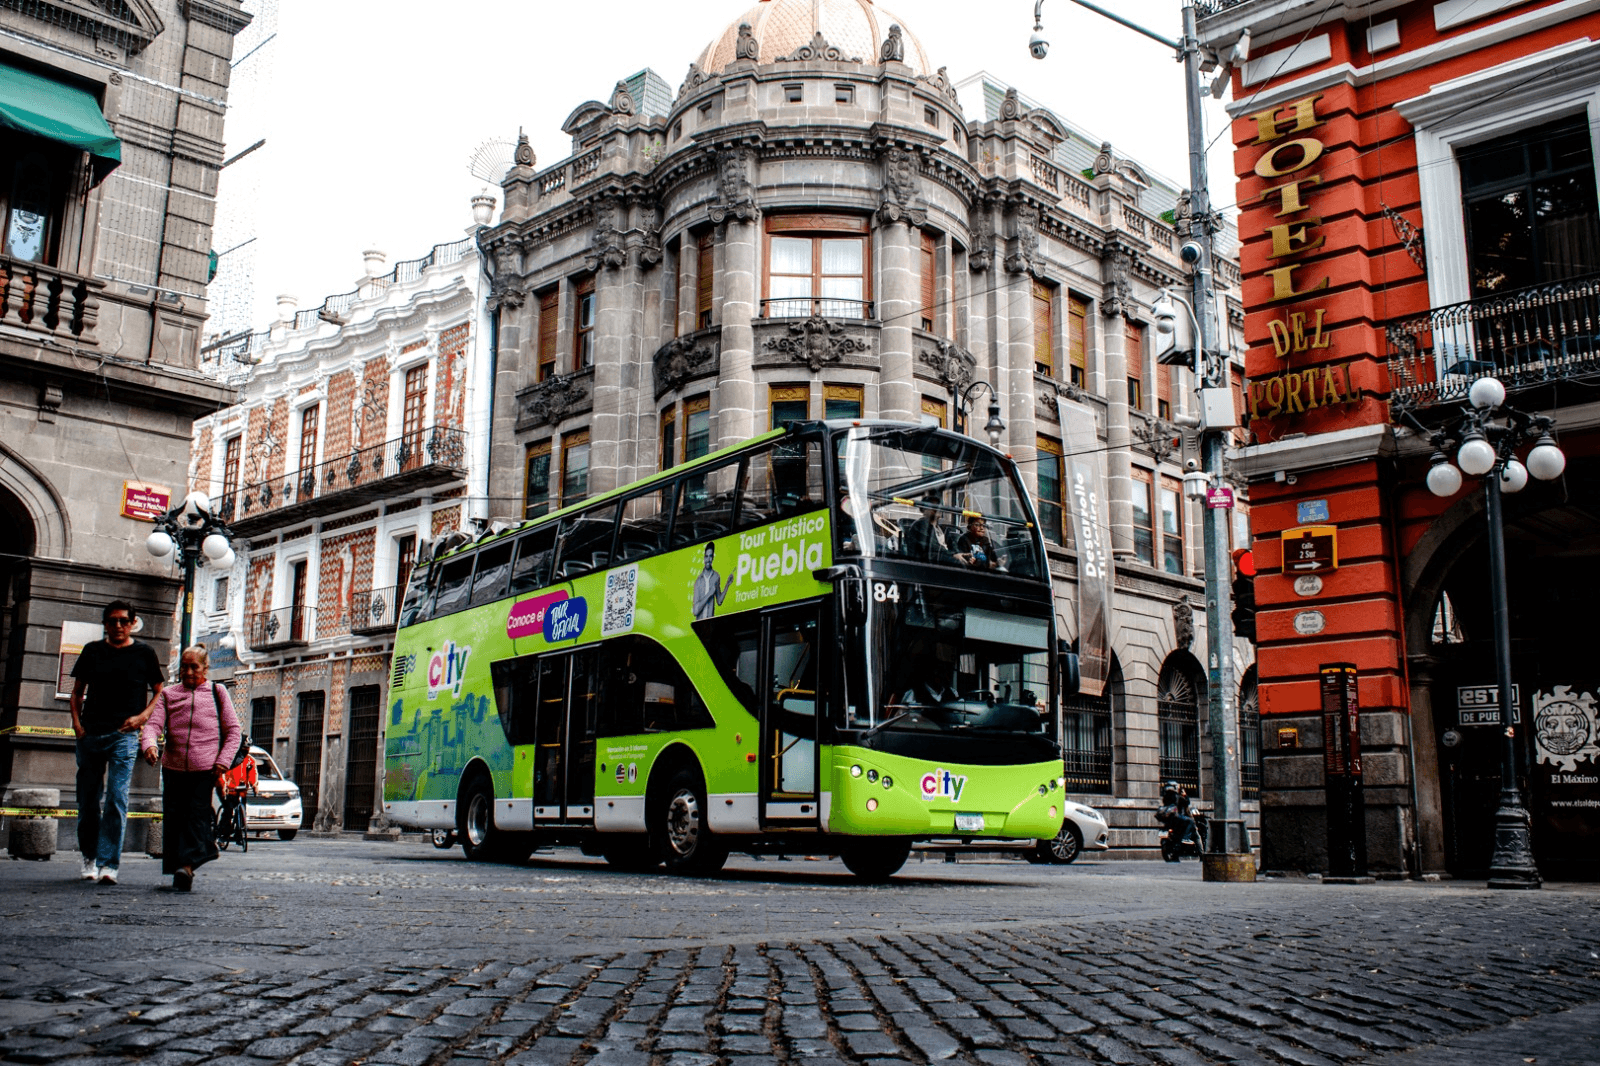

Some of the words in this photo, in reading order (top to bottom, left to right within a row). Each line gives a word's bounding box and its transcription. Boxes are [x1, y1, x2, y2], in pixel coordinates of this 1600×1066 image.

[1250, 95, 1330, 302] HOTEL
[1267, 308, 1331, 358] DEL
[1249, 362, 1363, 422] PORTAL
[740, 532, 766, 551] Tour
[768, 516, 824, 544] Turístico
[1074, 472, 1097, 577] Desarrollo
[1299, 550, 1304, 559] 2
[1304, 550, 1316, 559] Sur
[1301, 542, 1314, 550] Calle
[736, 538, 823, 587] Puebla
[736, 586, 759, 603] Travel
[760, 584, 778, 598] Tour
[873, 580, 900, 603] 84
[507, 611, 536, 630] Conoce
[536, 607, 546, 622] el
[551, 600, 569, 626] TOUR
[552, 613, 580, 641] OFICIAL
[428, 641, 469, 696] city
[1463, 713, 1475, 722] DE
[921, 769, 966, 801] city
[1551, 774, 1561, 784] El
[1562, 774, 1599, 784] Máximo
